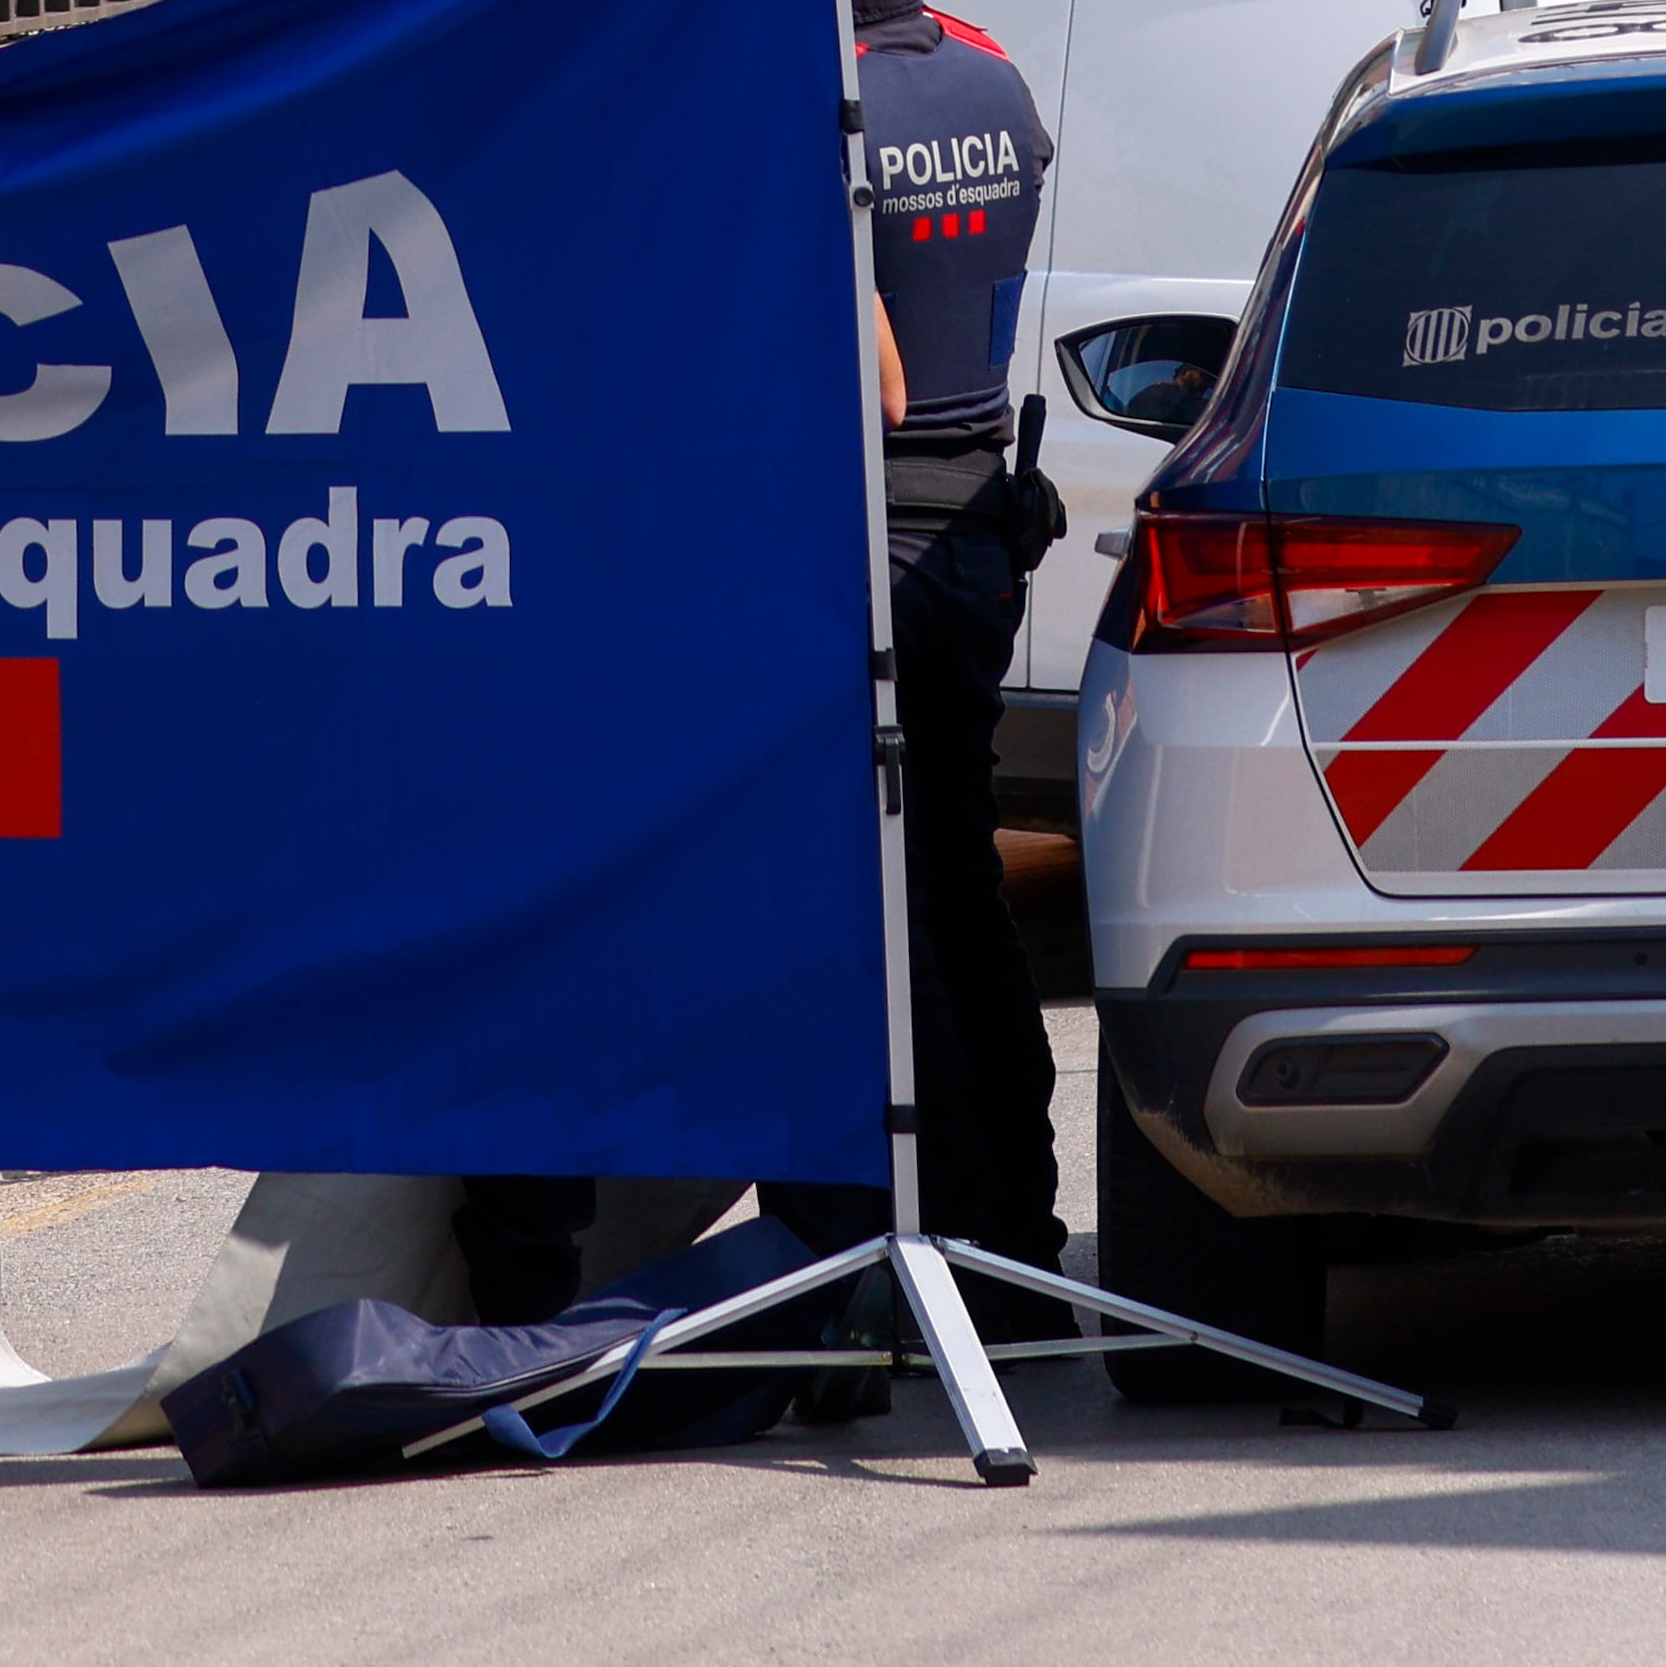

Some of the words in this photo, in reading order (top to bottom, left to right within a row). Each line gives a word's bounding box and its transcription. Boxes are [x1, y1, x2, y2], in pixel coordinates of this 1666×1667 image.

[879, 130, 1020, 190] POLICIA
[882, 191, 943, 214] mossos
[946, 177, 1021, 208] d'esquadra
